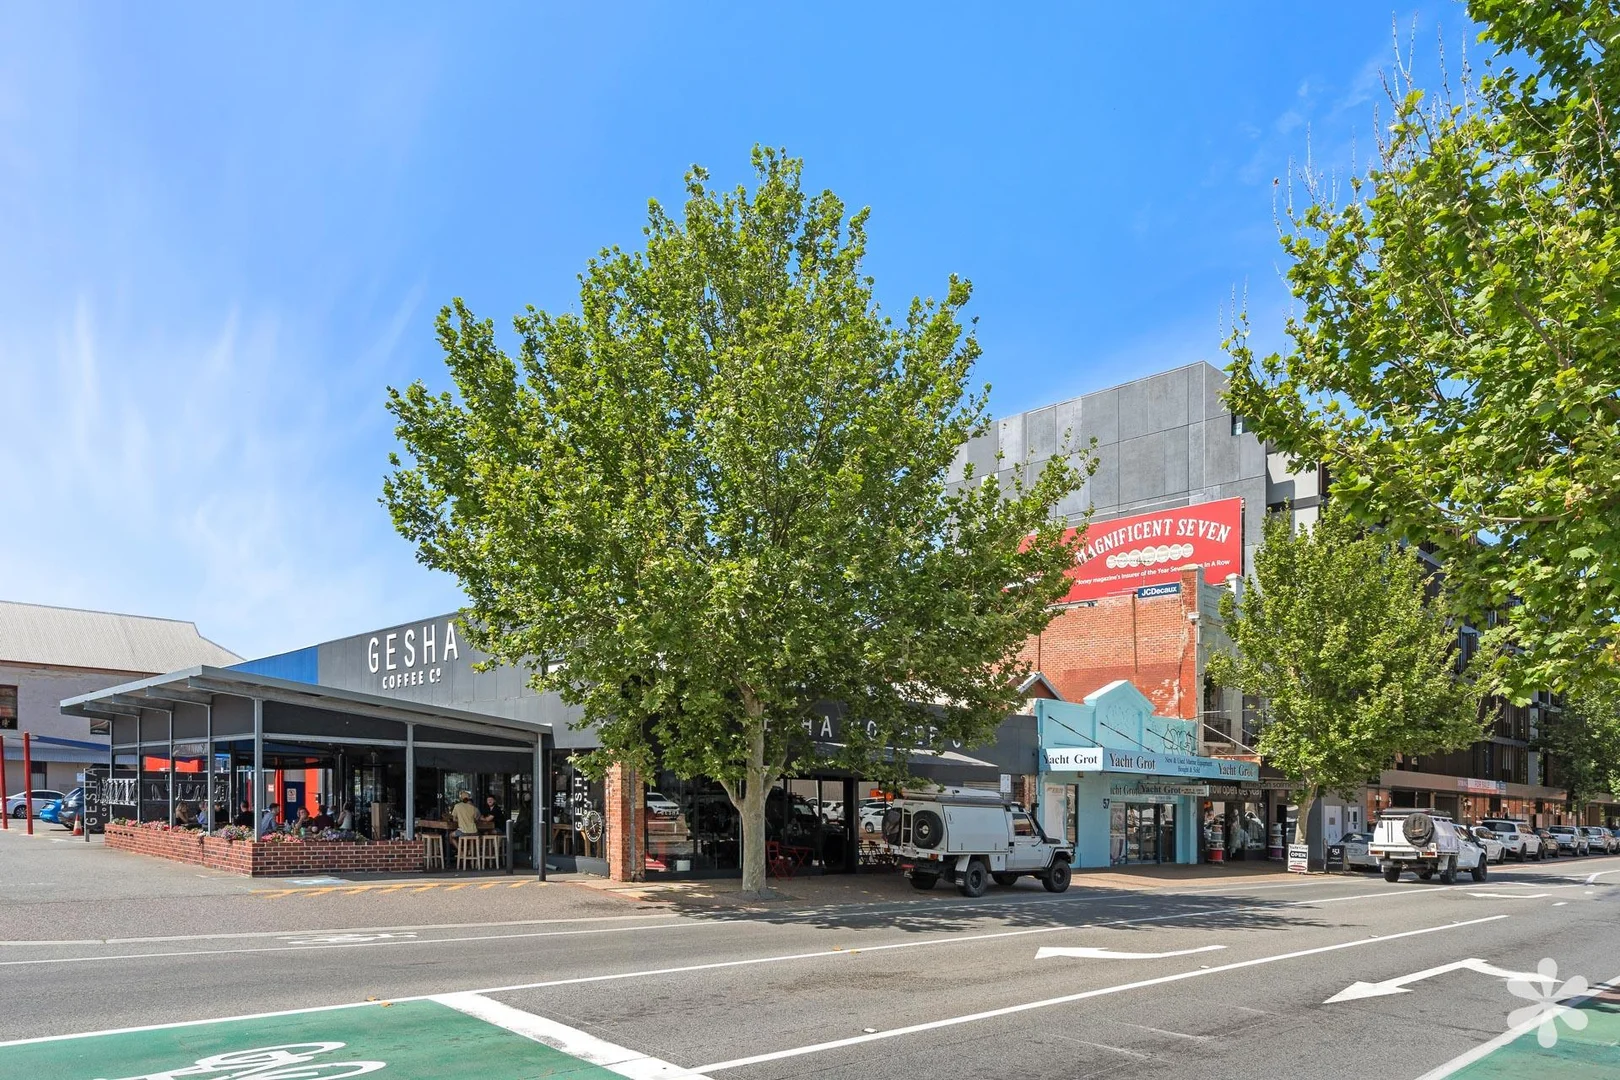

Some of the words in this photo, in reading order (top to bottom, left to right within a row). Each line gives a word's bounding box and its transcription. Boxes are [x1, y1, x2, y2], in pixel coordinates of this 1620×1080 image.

[1075, 519, 1173, 564] MAGNIFICENT
[1176, 519, 1231, 543] SEVEN
[1093, 574, 1120, 583] magazine's
[1141, 585, 1177, 597] JCDecaux
[368, 622, 459, 673] GESHA
[382, 670, 424, 690] COFFEE
[1043, 754, 1069, 765] Yacht
[1074, 753, 1098, 764] Grot
[1109, 753, 1133, 769] Yacht
[1136, 755, 1156, 770] Grot
[1218, 762, 1236, 776] Yacht
[1140, 784, 1161, 793] Yacht
[1163, 785, 1181, 794] Grot
[1222, 785, 1238, 796] open
[85, 768, 98, 826] GESHA
[574, 768, 583, 831] GESH
[1103, 798, 1110, 809] 57
